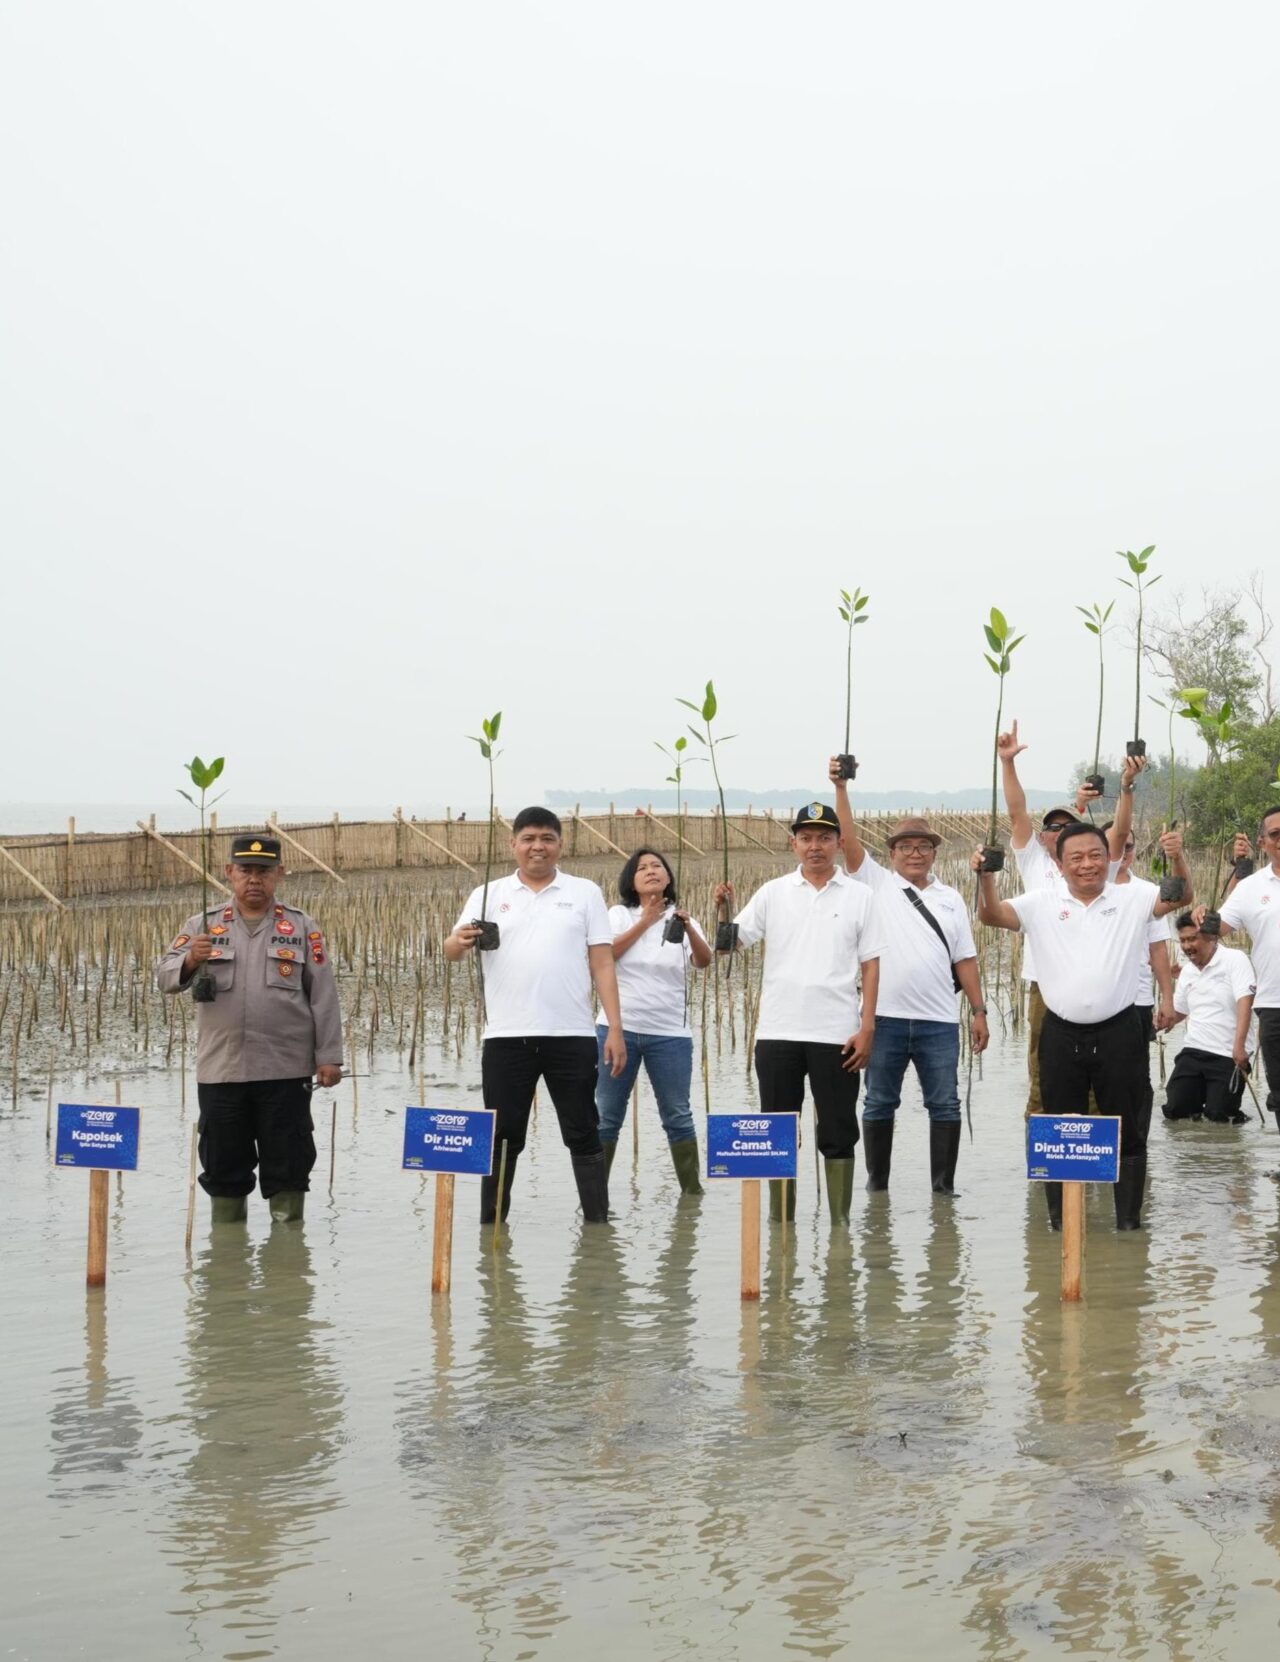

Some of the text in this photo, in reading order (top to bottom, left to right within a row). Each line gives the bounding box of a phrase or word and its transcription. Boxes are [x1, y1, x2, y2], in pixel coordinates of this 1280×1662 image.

[271, 936, 302, 946] POLRI
[72, 1130, 123, 1143] Kapolsek
[424, 1133, 473, 1146] Dir HCM
[732, 1140, 773, 1150] Camat
[1034, 1142, 1113, 1154] Dirut Telkom
